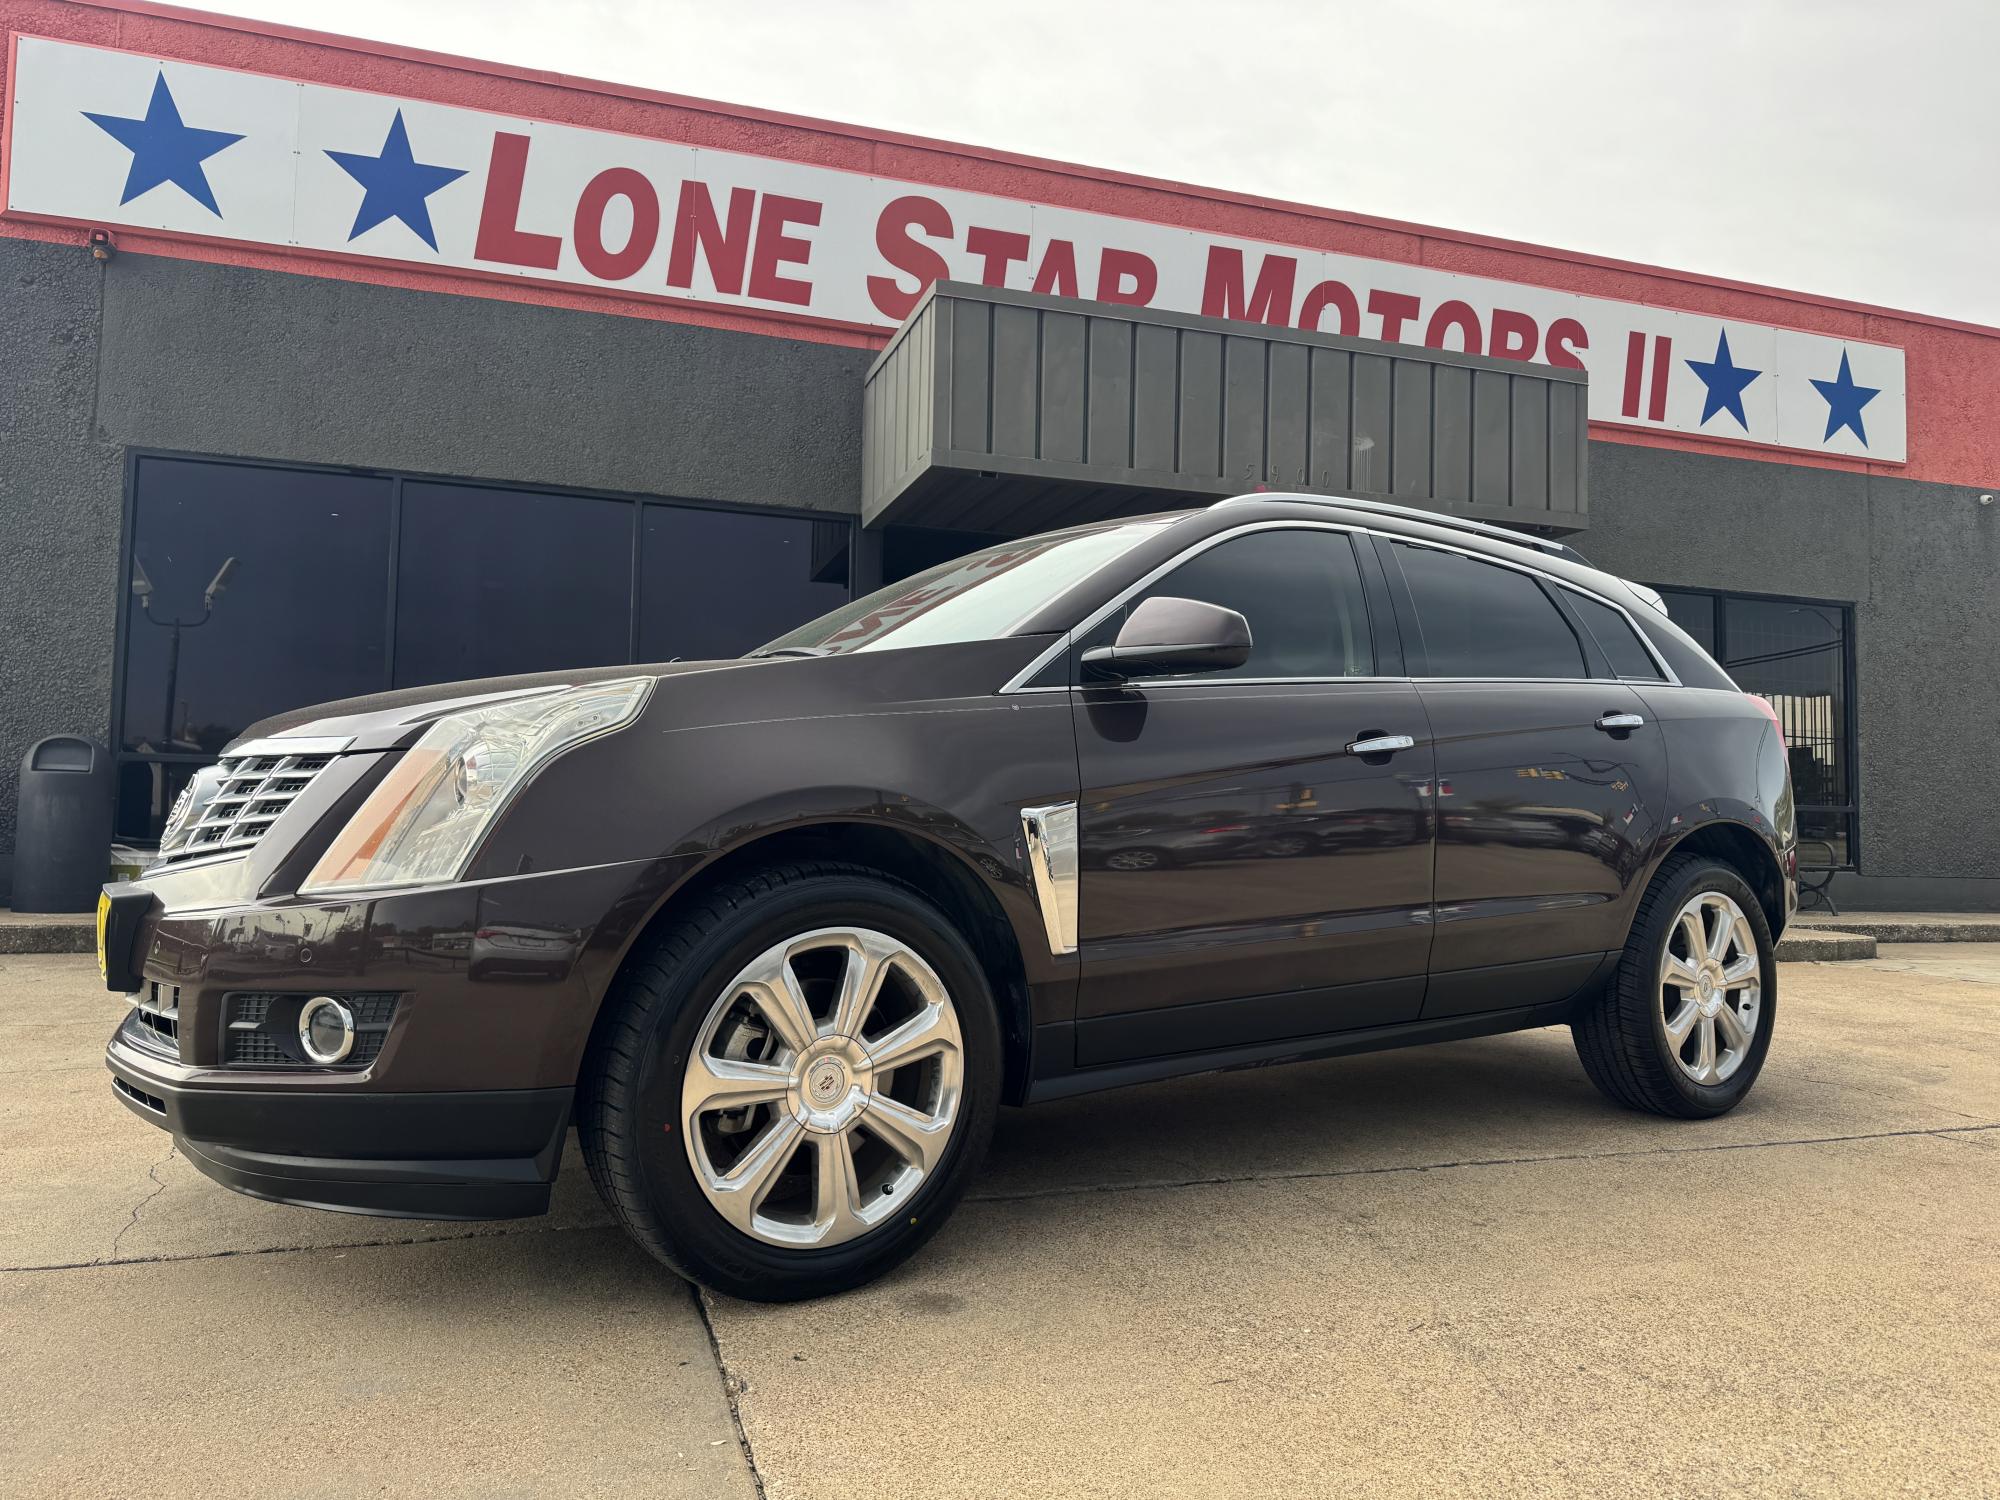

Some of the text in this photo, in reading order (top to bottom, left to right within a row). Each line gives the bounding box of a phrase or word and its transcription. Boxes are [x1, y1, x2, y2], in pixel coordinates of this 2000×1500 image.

[474, 131, 823, 306] LONE
[1621, 331, 1672, 422] II
[1243, 464, 1329, 488] 5900
